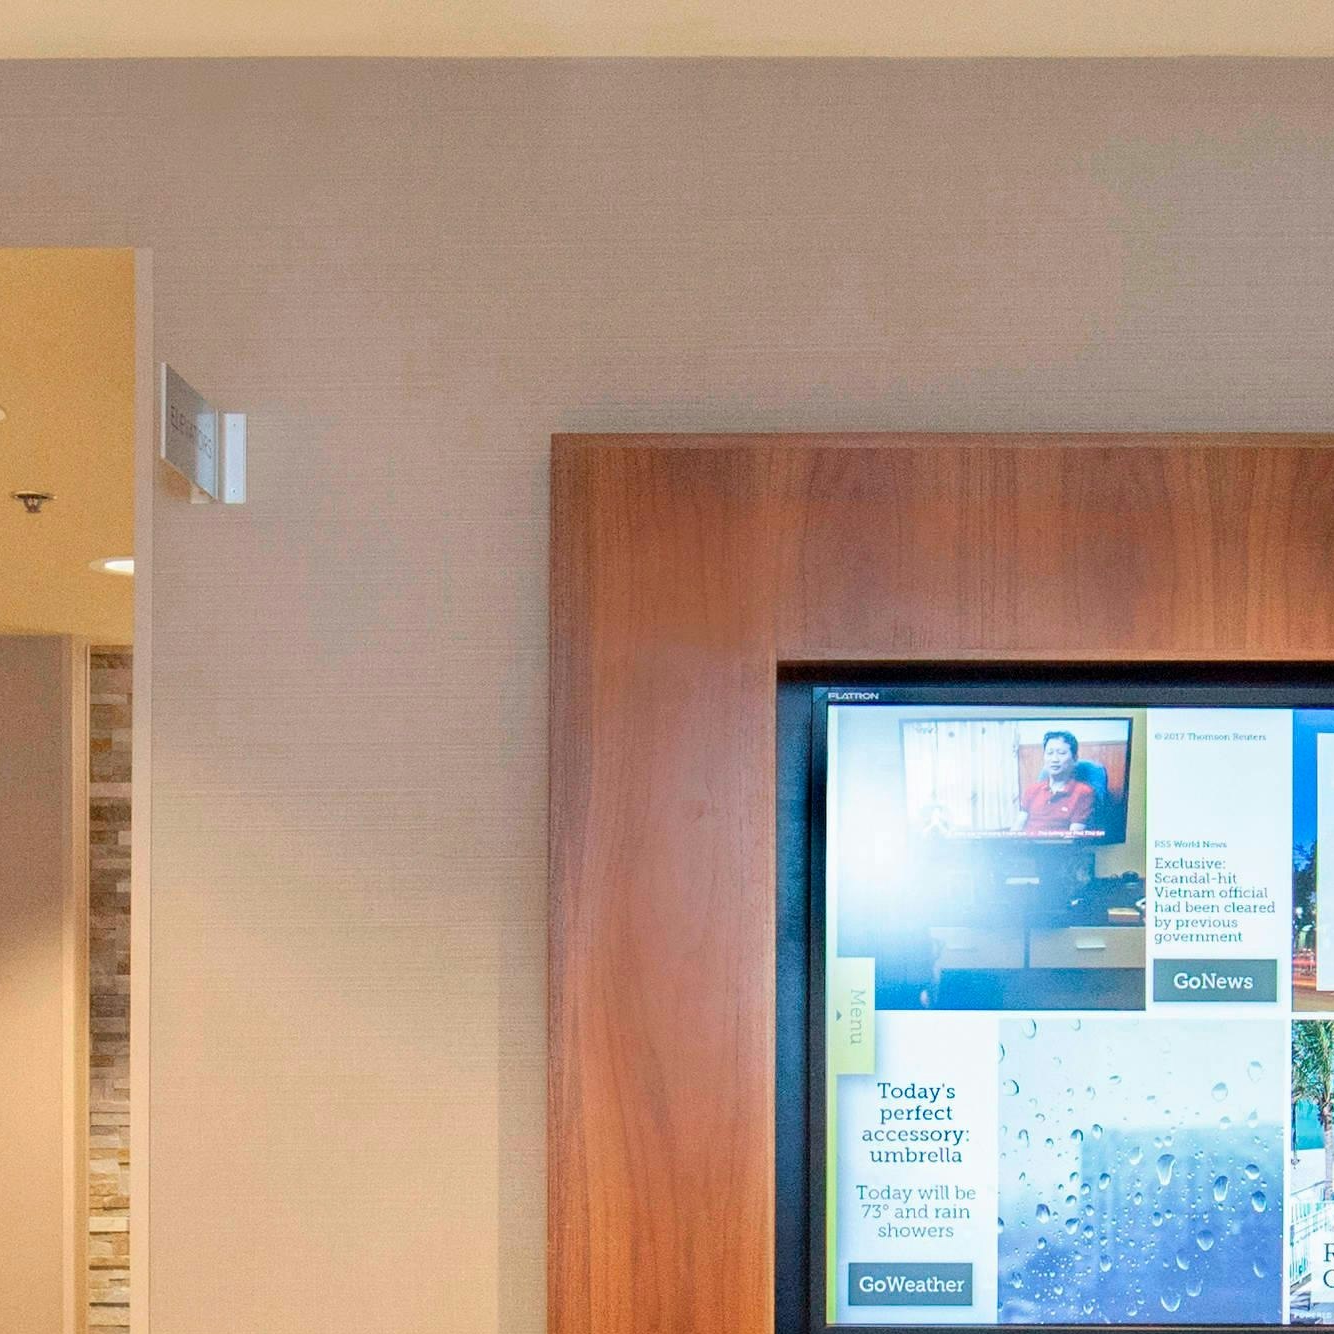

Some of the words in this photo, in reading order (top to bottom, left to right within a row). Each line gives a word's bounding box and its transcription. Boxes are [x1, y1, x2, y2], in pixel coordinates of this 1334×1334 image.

[827, 692, 880, 700] FLATRON
[1164, 732, 1186, 741] 2017
[1187, 732, 1231, 741] Thomson
[1232, 732, 1267, 742] Reuters
[1154, 840, 1172, 848] RSS
[1173, 840, 1201, 848] World
[1202, 840, 1228, 849] News
[1154, 857, 1227, 870] Exclusive:
[1154, 872, 1238, 885] Scandal-hit
[1154, 886, 1216, 899] Vietnam
[1218, 886, 1269, 899] official
[1154, 901, 1181, 913] had
[1185, 901, 1220, 913] been
[1223, 901, 1276, 914] cleared
[1154, 916, 1172, 930] by
[1175, 917, 1239, 930] previous
[1154, 932, 1244, 945] government
[1173, 972, 1254, 990] GoNews
[849, 989, 866, 1046] Menu
[876, 1082, 957, 1103] Today's
[880, 1105, 954, 1125] perfect
[861, 1129, 970, 1146] accessory:
[869, 1146, 963, 1163] umbrella
[855, 1184, 914, 1204] Today
[918, 1184, 950, 1201] will
[954, 1184, 977, 1201] be
[860, 1203, 890, 1219] 73°
[893, 1203, 930, 1219] and
[934, 1203, 971, 1219] rain
[877, 1222, 955, 1238] showers
[858, 1276, 966, 1293] GoWeather
